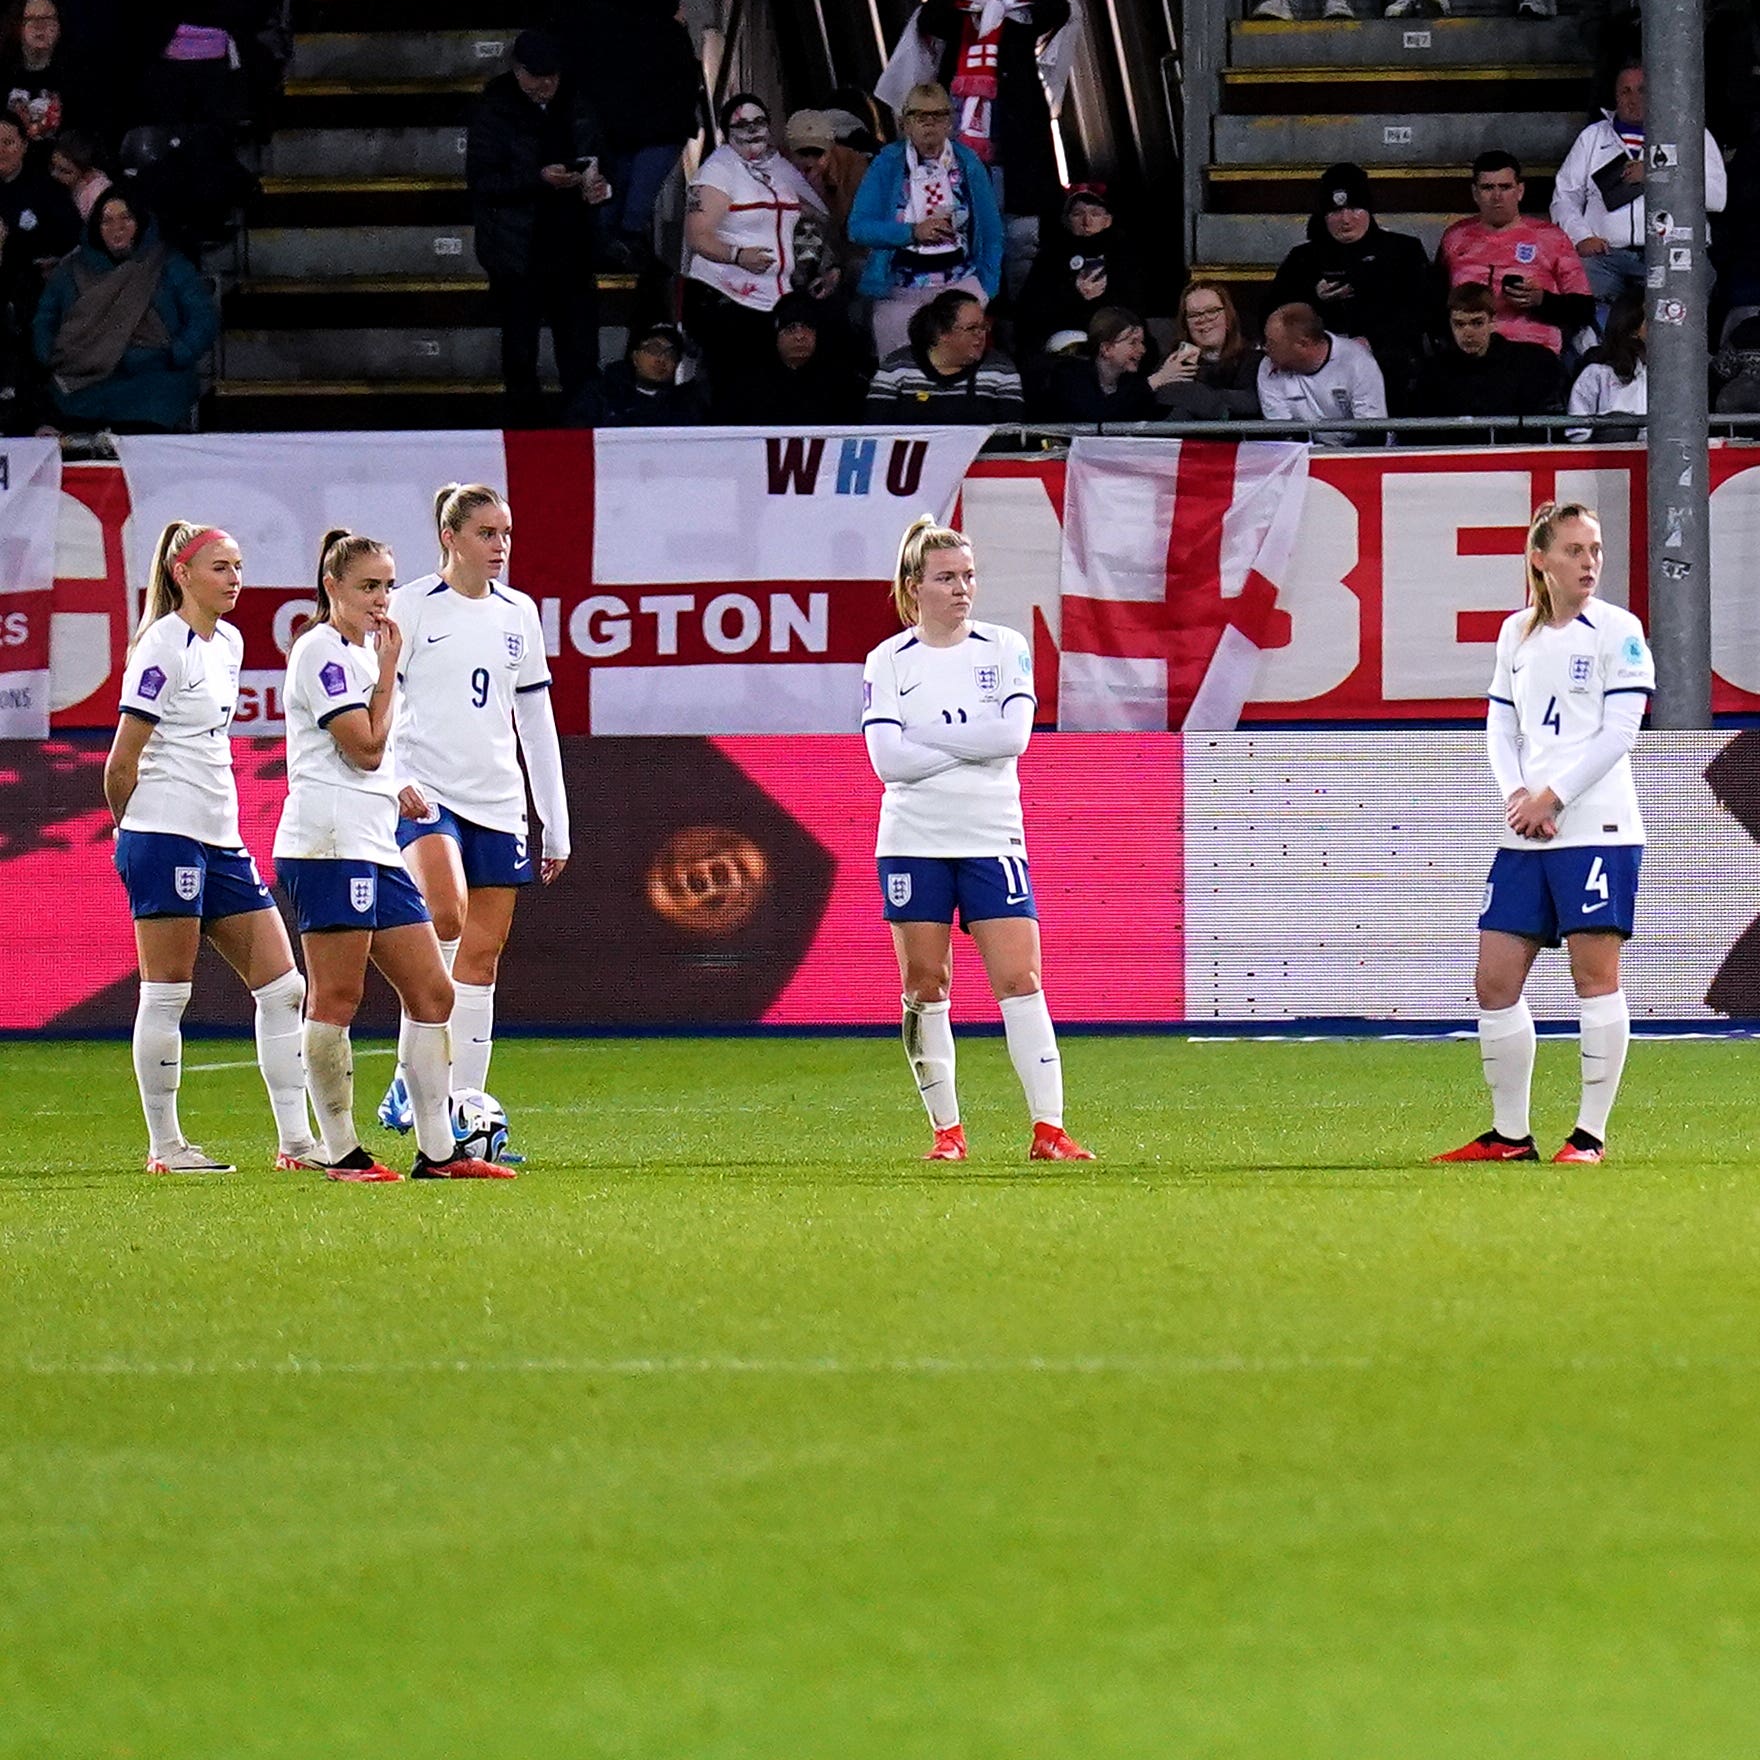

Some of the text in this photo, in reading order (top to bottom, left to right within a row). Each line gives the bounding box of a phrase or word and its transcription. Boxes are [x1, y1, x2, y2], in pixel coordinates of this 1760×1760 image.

[766, 437, 929, 497] WHU
[471, 667, 490, 709] 9
[1541, 695, 1561, 736] 4
[997, 855, 1029, 896] 11
[1584, 856, 1609, 900] 4
